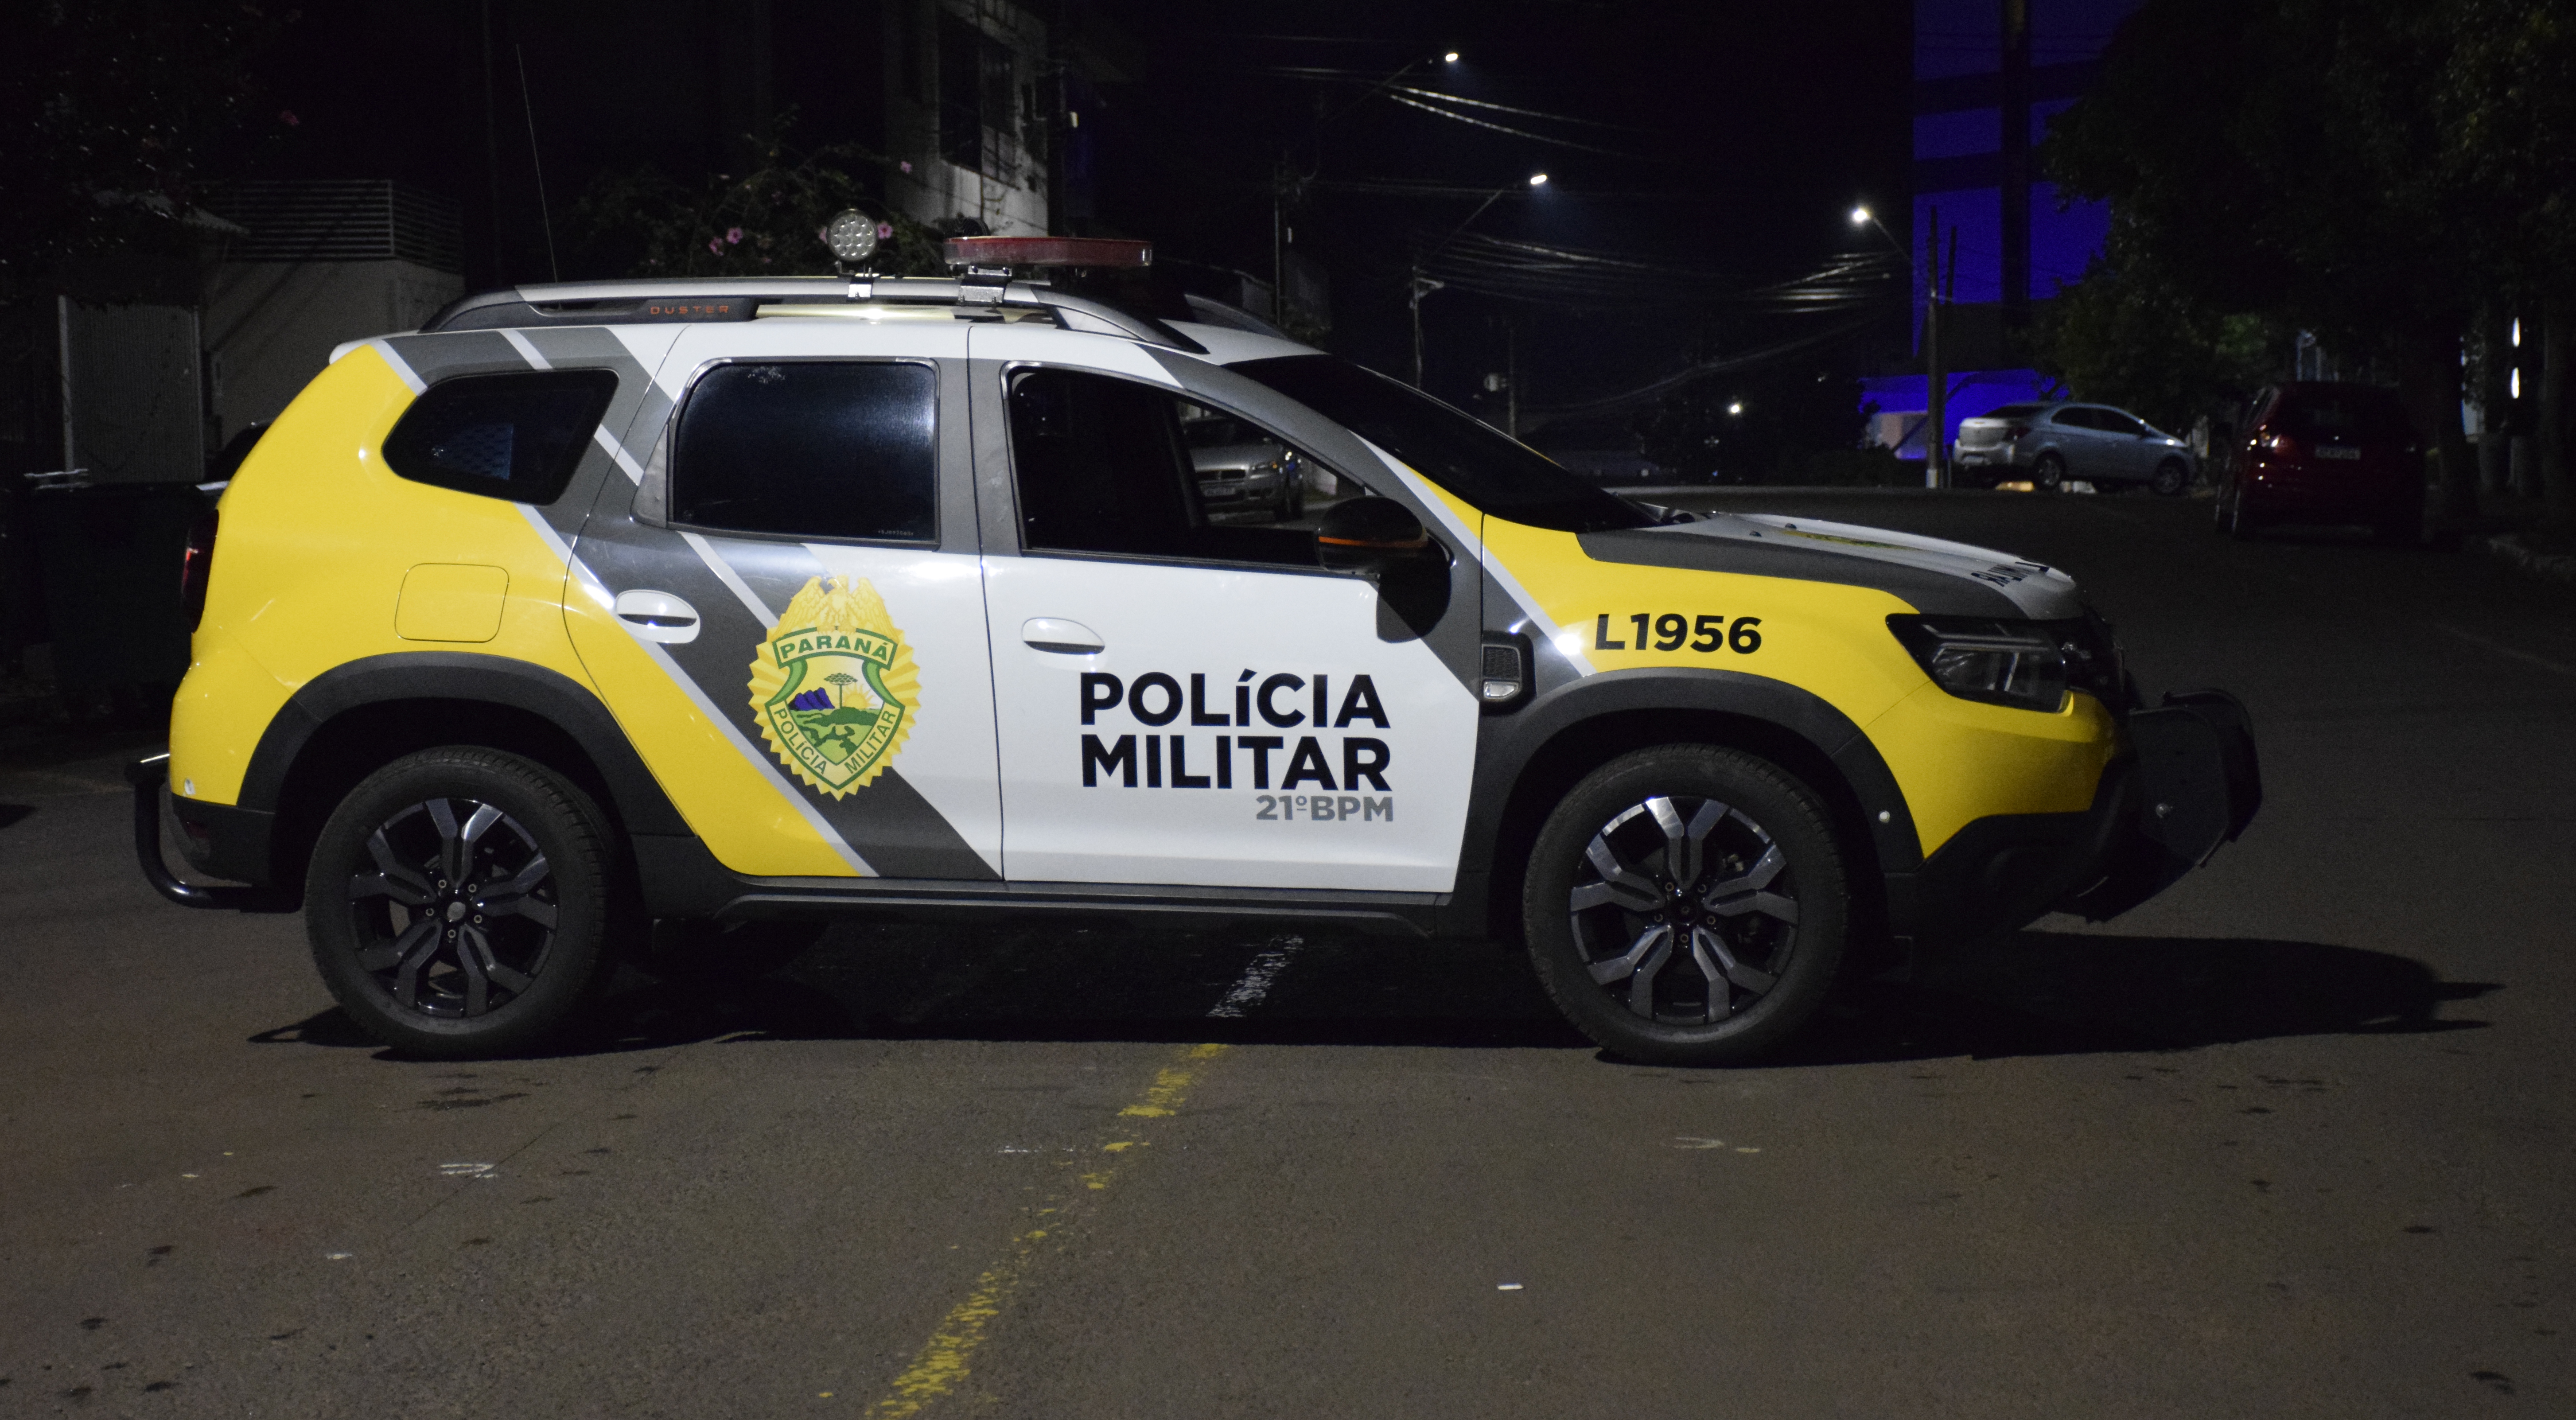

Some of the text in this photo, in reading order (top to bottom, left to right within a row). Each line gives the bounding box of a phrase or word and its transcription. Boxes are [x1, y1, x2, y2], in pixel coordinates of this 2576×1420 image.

[650, 305, 729, 315] DUSTER
[780, 635, 887, 660] PARANÁ
[1595, 613, 1763, 654] L1956
[774, 708, 896, 774] POLÍCIA MILITAR
[1081, 734, 1393, 792] MILITAR
